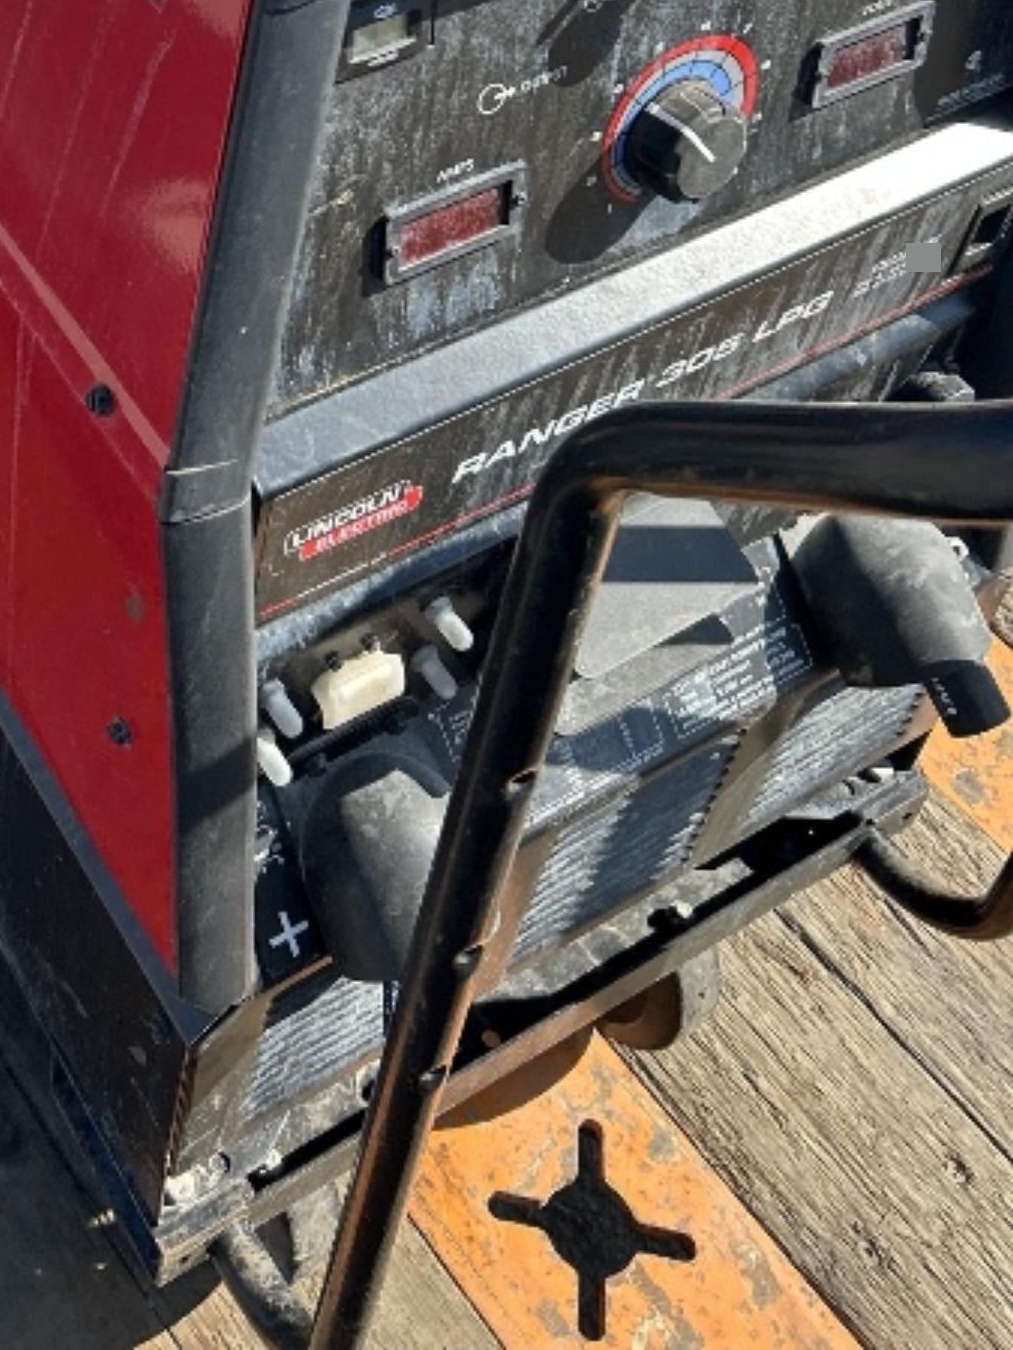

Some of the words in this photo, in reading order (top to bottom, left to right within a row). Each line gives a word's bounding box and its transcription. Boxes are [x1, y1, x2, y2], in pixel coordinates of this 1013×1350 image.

[451, 377, 646, 484] RANGER
[655, 332, 747, 388] 305
[751, 290, 834, 343] LPG
[292, 482, 403, 546] LINCOLN
